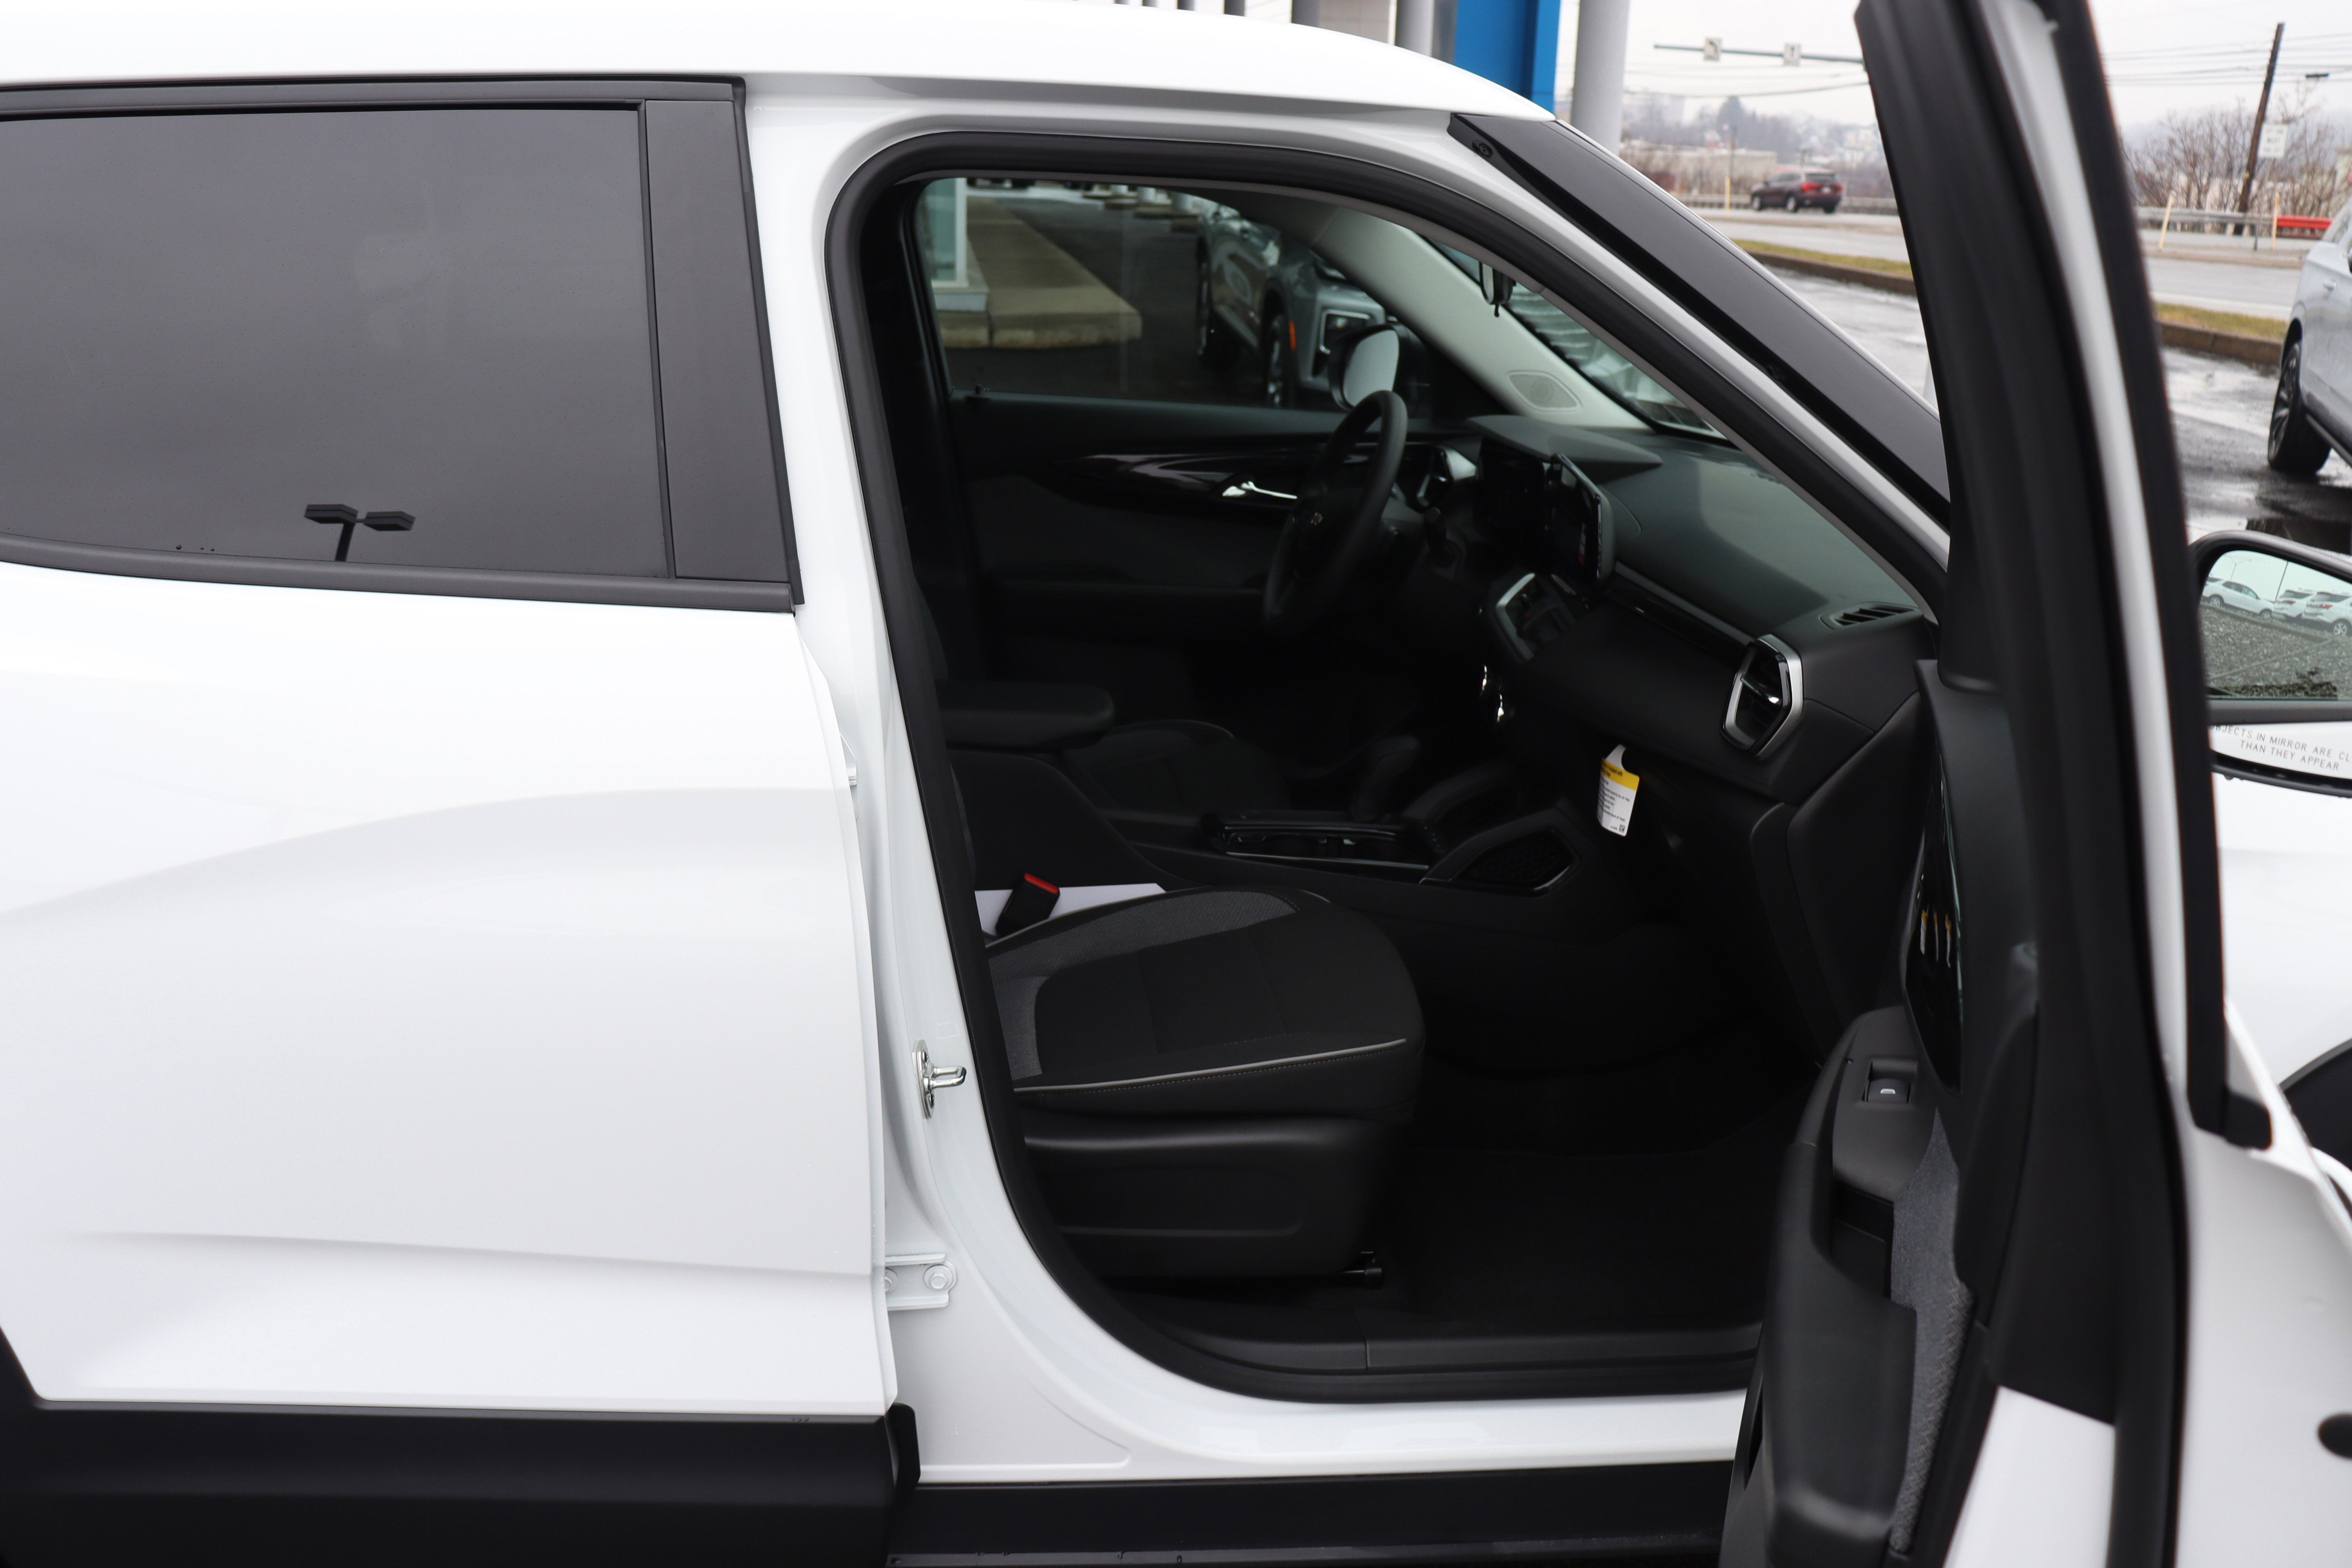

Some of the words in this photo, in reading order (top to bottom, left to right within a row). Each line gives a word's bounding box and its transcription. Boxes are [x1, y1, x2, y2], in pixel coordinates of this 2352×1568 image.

[2241, 739, 2266, 753] THAN
[2271, 746, 2296, 760] THEY
[2300, 755, 2339, 771] APPEAR
[2256, 733, 2266, 742] IN
[2270, 736, 2307, 752] MIRROR
[2313, 746, 2332, 758] ARE
